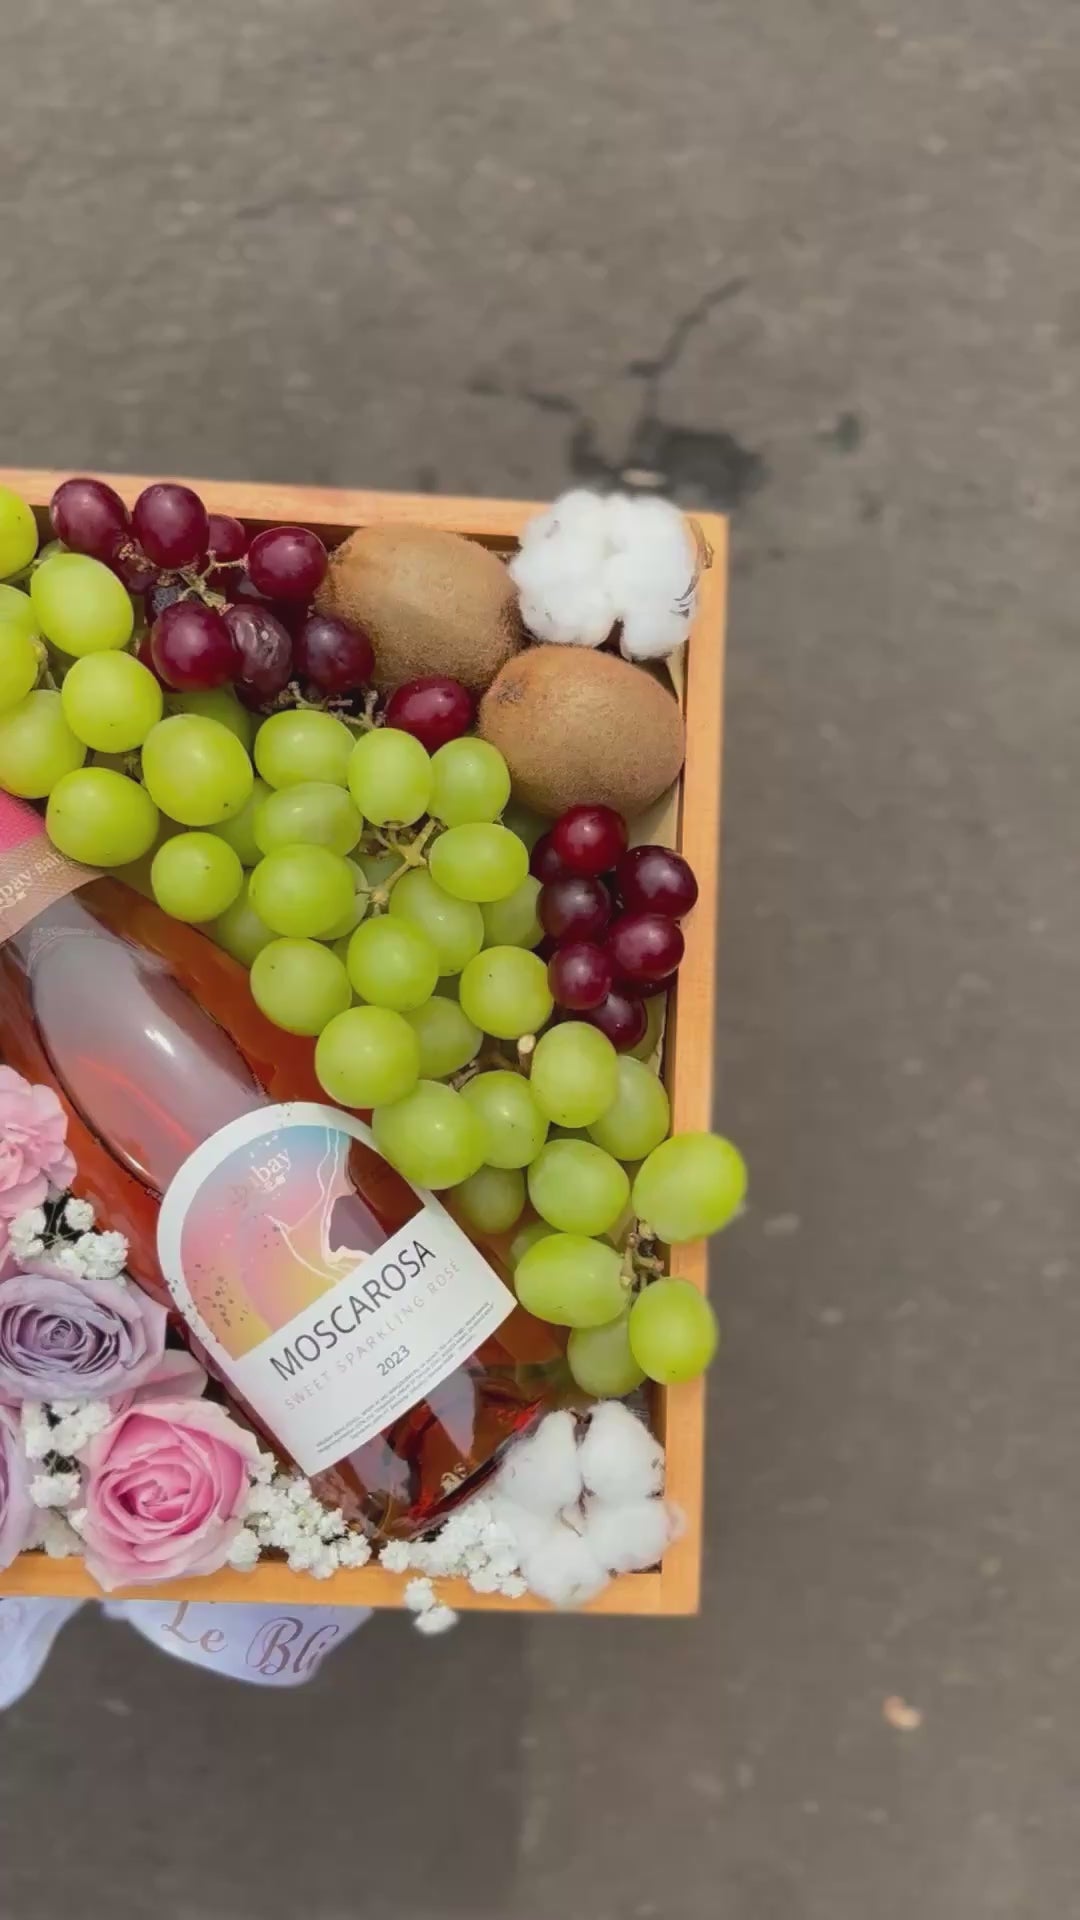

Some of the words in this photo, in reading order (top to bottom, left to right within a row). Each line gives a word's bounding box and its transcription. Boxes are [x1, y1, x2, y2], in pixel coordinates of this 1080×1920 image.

[269, 1240, 436, 1381] MOSCAROSA
[284, 1371, 329, 1411] SWEET
[337, 1297, 425, 1374] SPARKLING
[376, 1345, 411, 1377] 2023
[160, 1601, 229, 1653] Le
